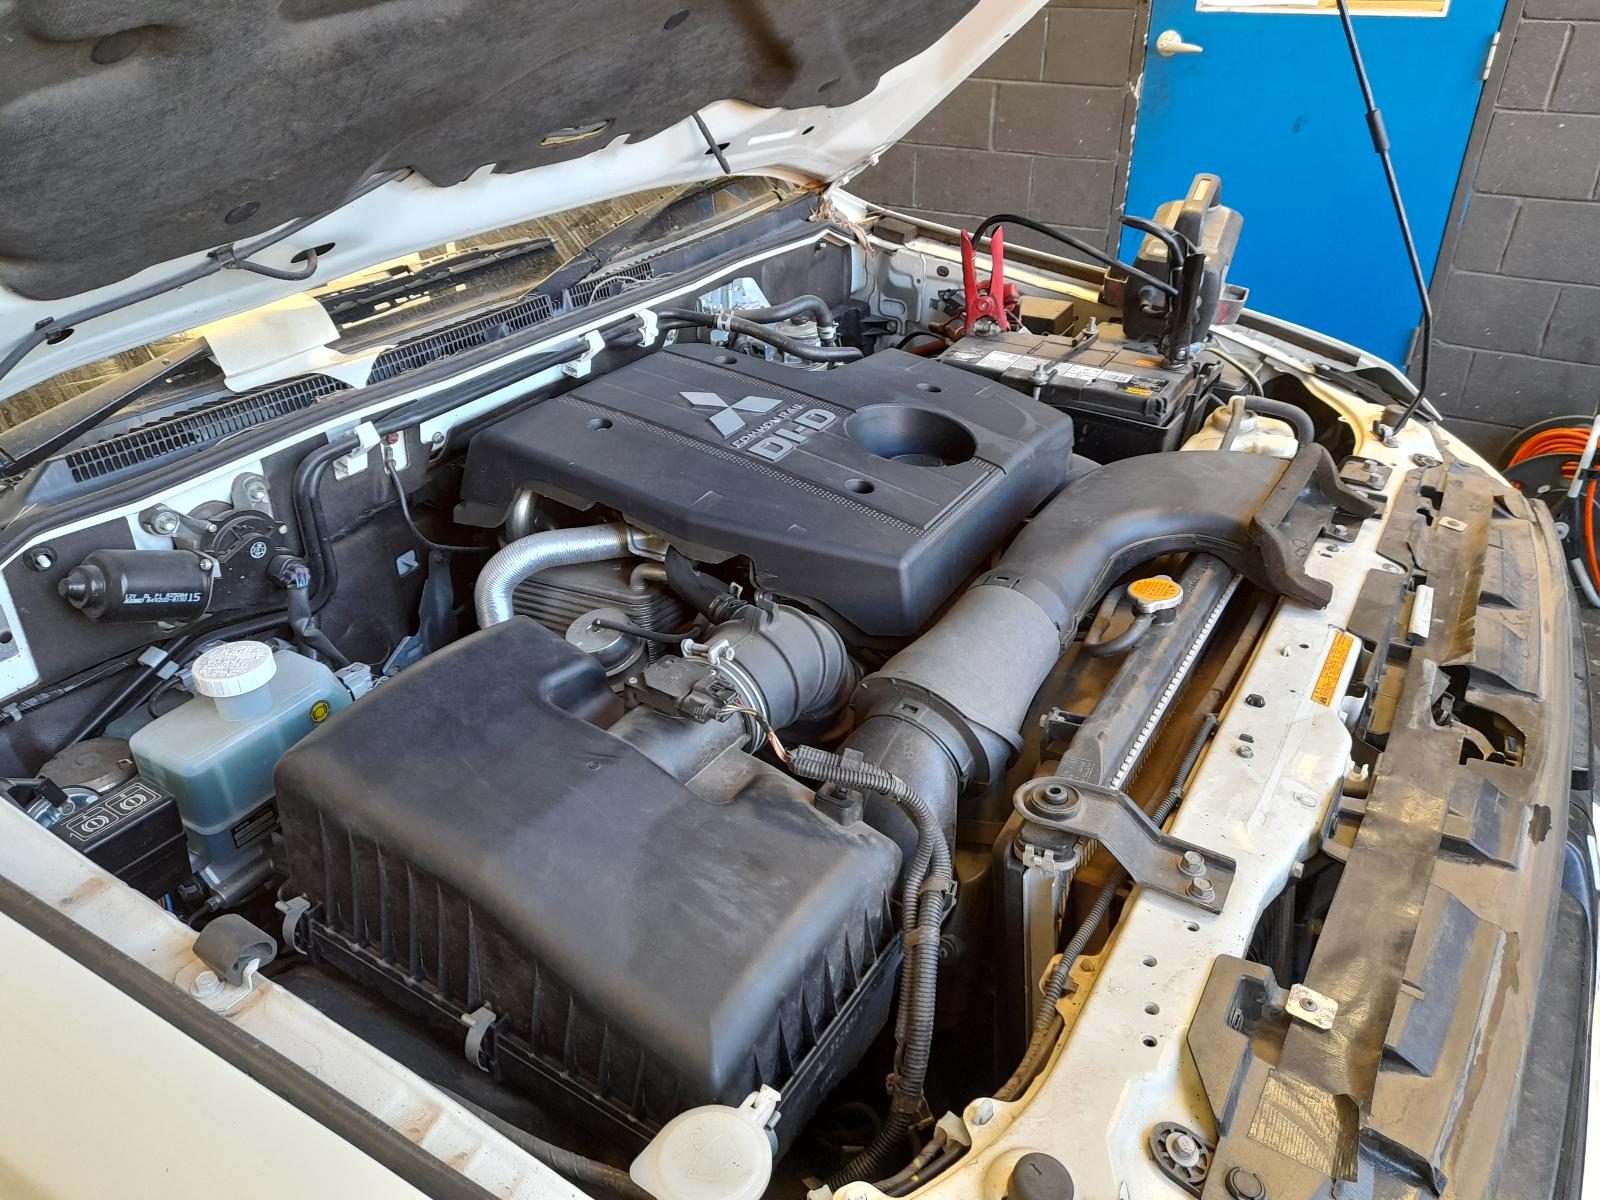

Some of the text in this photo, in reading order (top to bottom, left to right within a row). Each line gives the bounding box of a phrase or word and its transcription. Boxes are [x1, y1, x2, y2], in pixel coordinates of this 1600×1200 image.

[731, 403, 806, 449] COMMON RAIL
[746, 408, 837, 463] DI-D
[188, 592, 202, 602] 15
